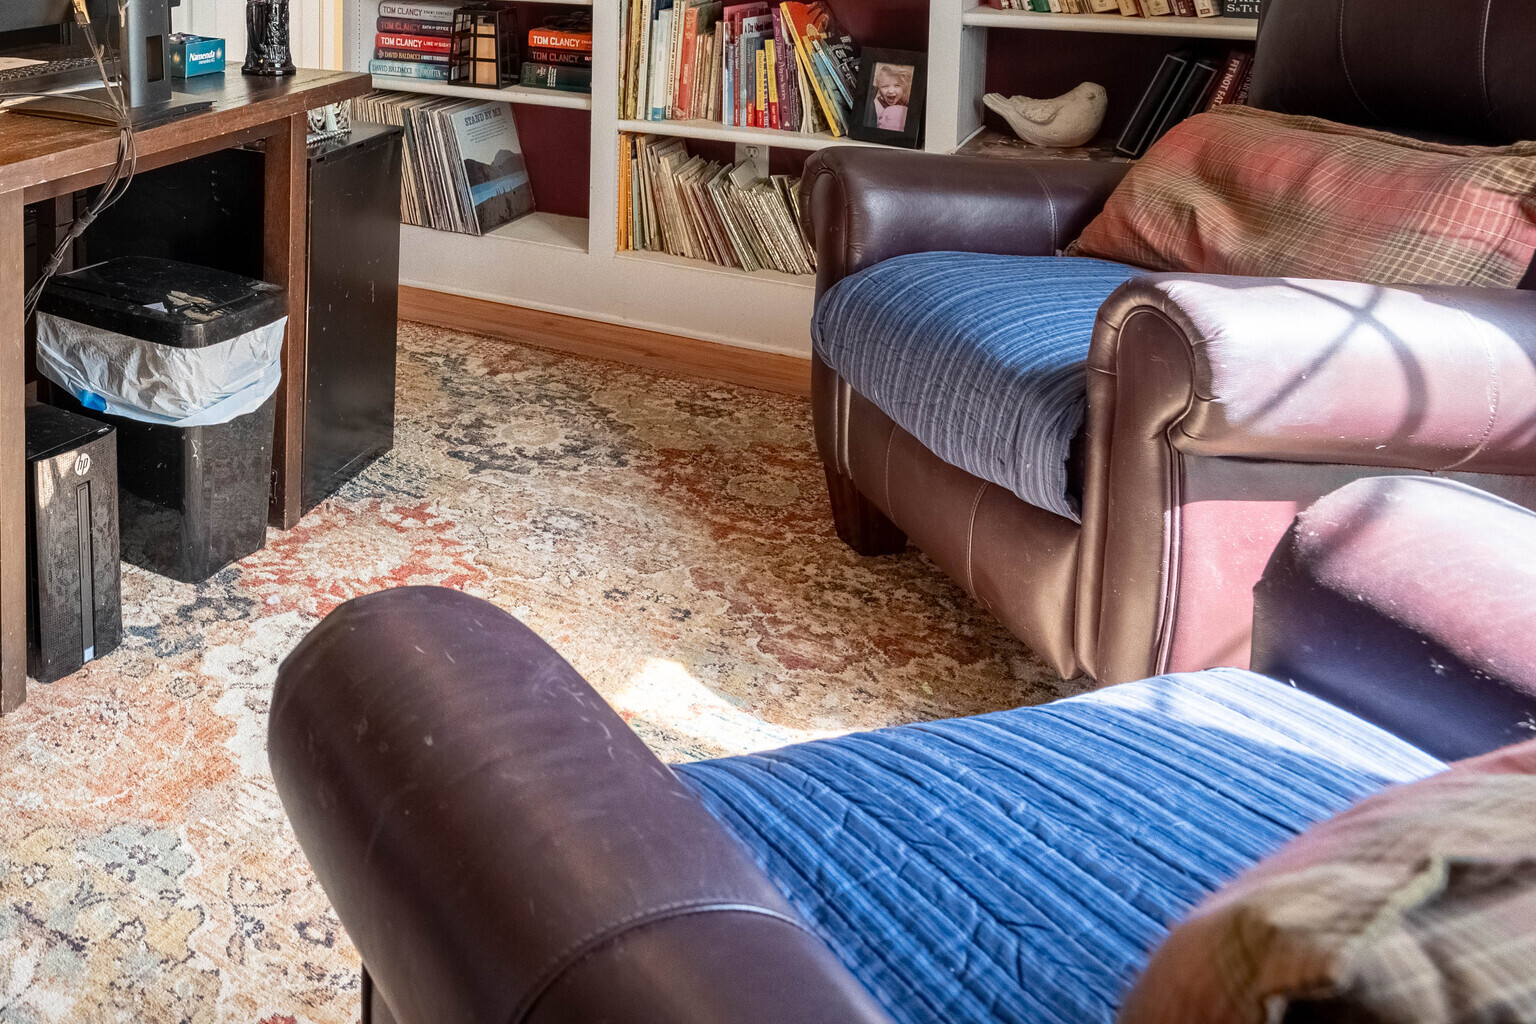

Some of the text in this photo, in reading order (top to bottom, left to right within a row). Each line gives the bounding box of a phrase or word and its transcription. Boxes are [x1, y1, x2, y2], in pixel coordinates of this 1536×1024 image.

[383, 6, 396, 14] TOM
[397, 7, 422, 16] CLANCY
[381, 21, 394, 30] TOM
[395, 22, 420, 31] CLANCY
[533, 35, 580, 48] TOM CLANCY
[189, 50, 216, 62] Namenda
[398, 52, 420, 60] BALDACCI
[372, 64, 412, 74] DAVID BALDACCI
[1214, 59, 1240, 106] FIT NOT FAT
[464, 107, 503, 126] STAND BY ME
[76, 453, 89, 475] hp
